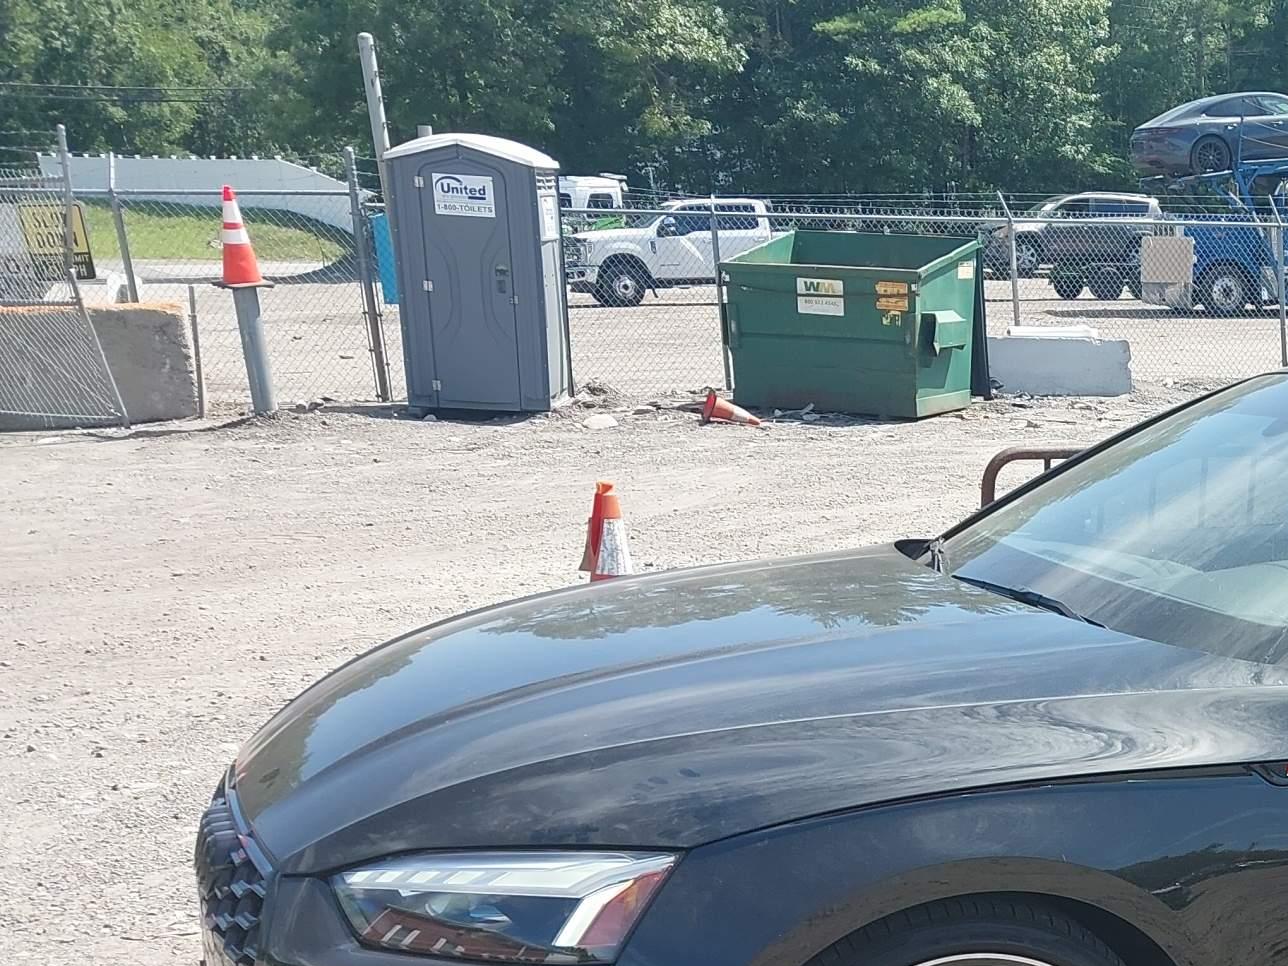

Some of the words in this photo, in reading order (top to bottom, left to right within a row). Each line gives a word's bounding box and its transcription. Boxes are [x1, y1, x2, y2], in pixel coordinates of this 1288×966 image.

[440, 182, 486, 196] United
[437, 204, 493, 213] 1-800-TOILETS
[803, 281, 835, 293] WM
